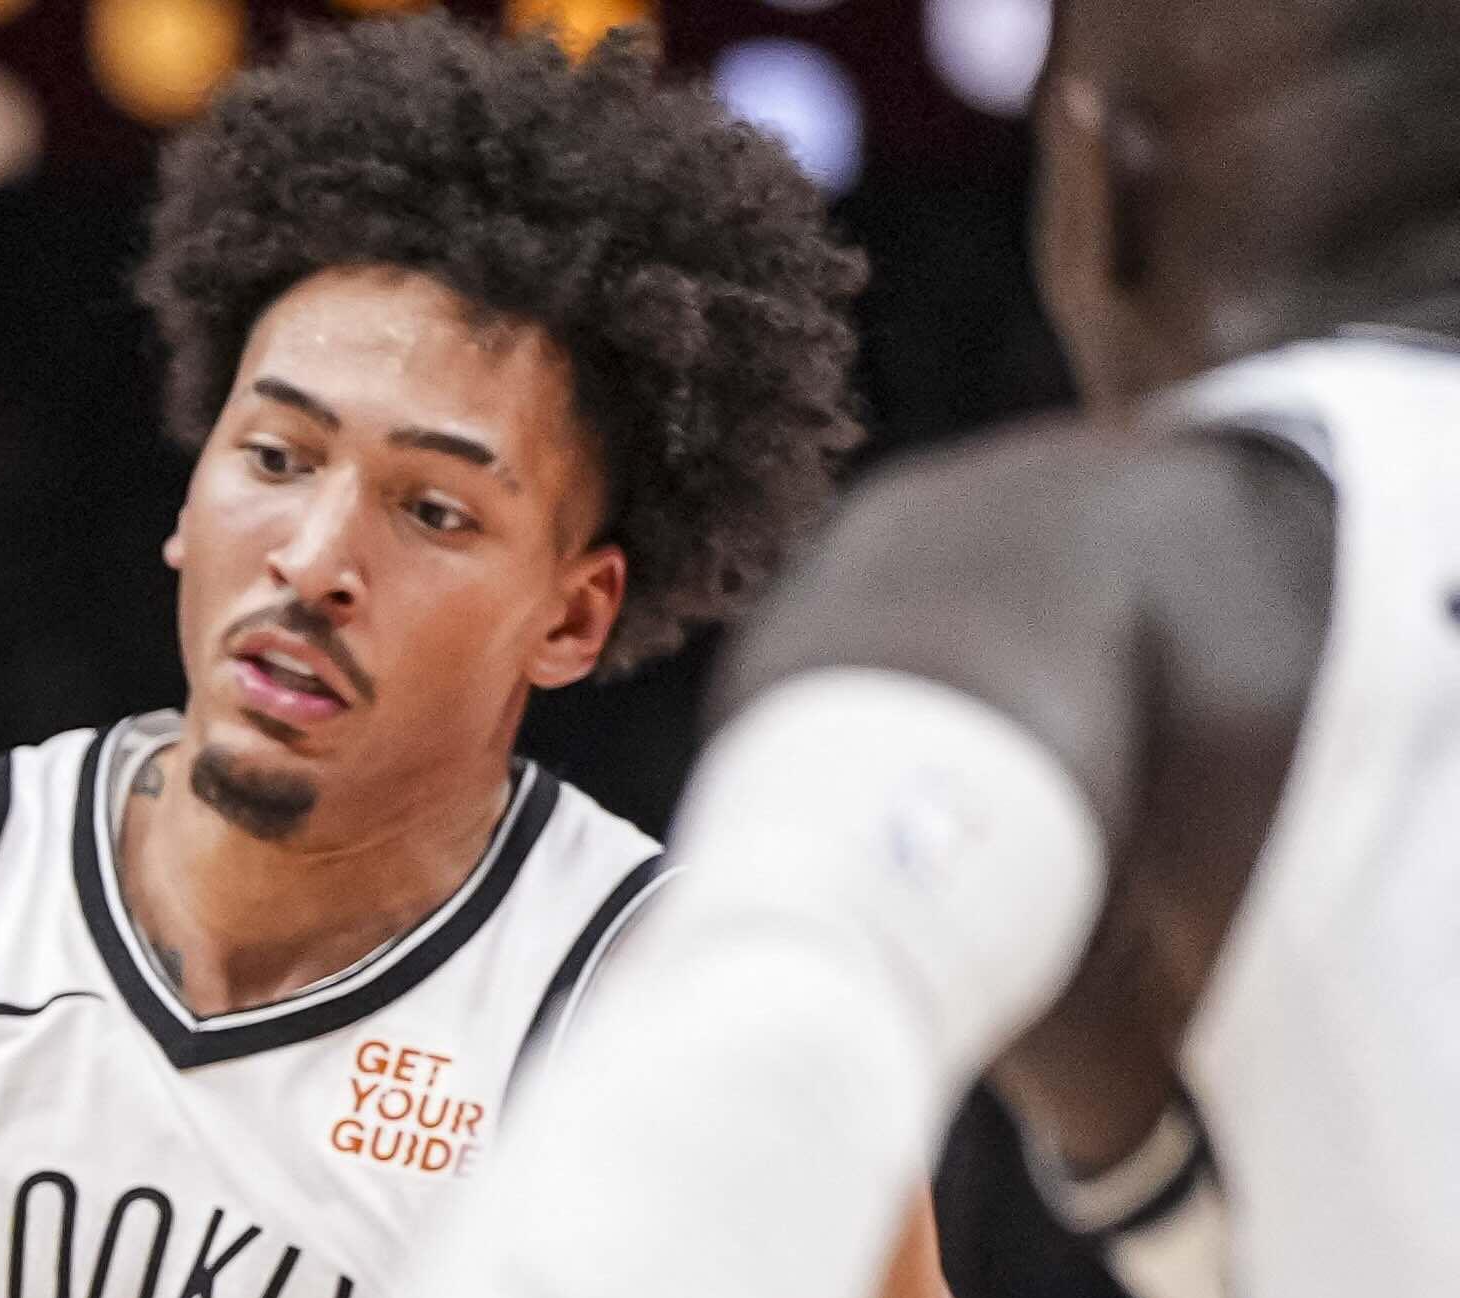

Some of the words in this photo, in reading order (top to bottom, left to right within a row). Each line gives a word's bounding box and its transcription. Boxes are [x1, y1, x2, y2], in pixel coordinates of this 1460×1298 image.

[356, 1040, 452, 1086] GET
[350, 1077, 485, 1136] YOUR
[331, 1118, 482, 1178] GUIDE
